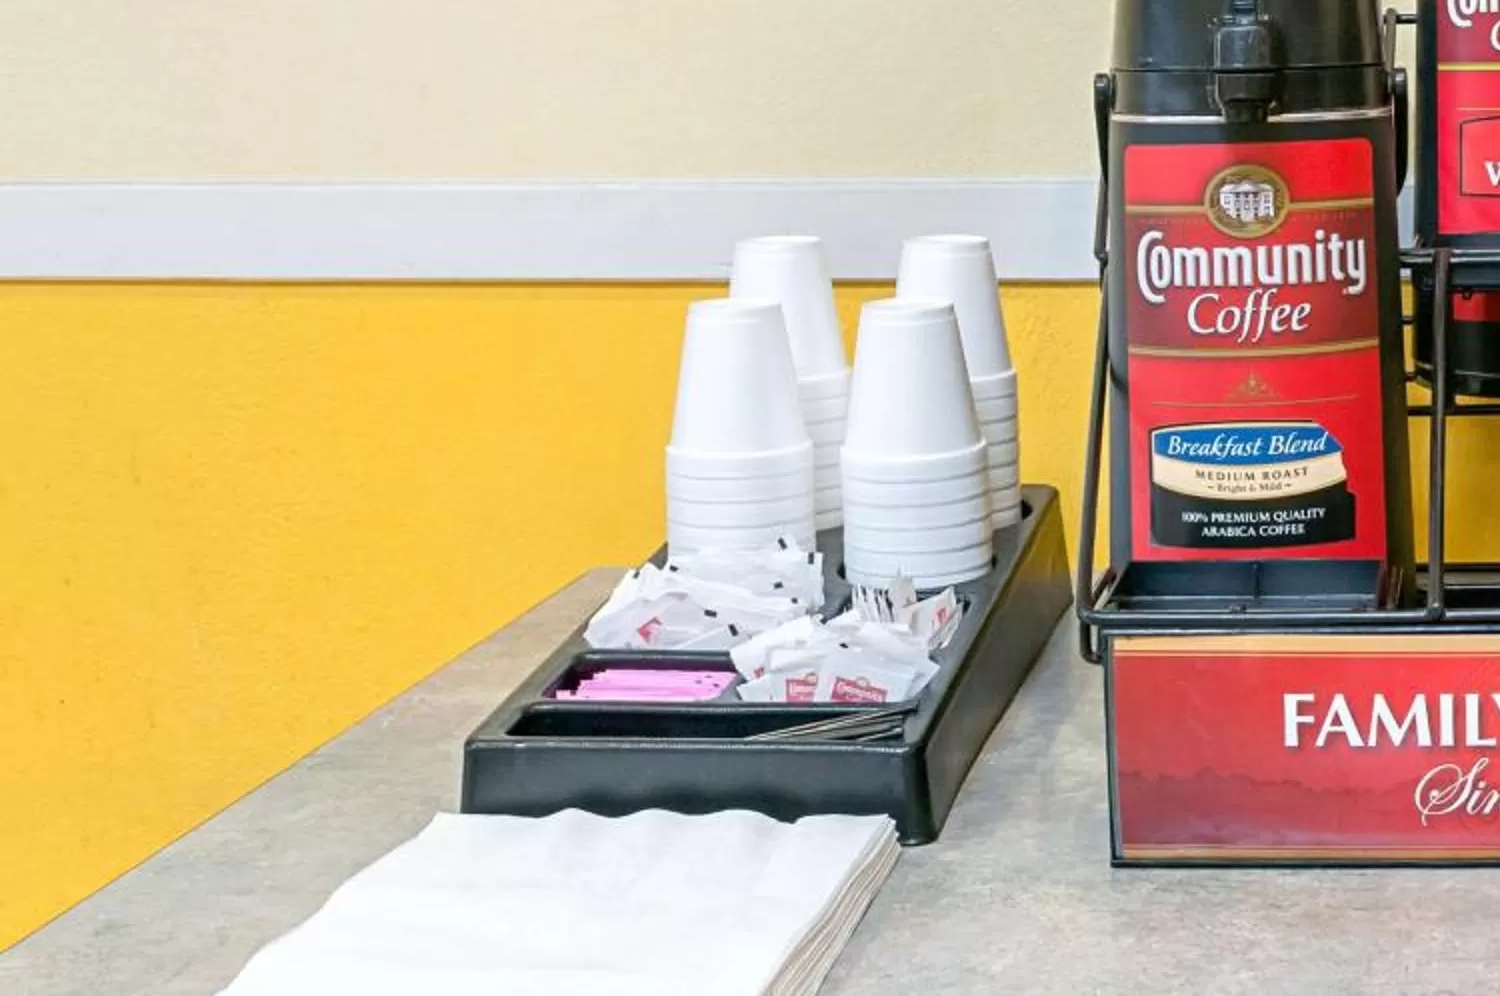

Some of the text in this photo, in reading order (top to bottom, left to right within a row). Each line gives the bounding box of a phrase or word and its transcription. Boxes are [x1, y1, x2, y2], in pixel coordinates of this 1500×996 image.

[1136, 229, 1366, 303] Community
[1186, 287, 1312, 343] Coffee
[1167, 431, 1329, 461] Breakfast Blend
[1194, 467, 1309, 481] MEDIUM ROAST
[1181, 507, 1327, 523] 100% PREMIUM QUALITY
[1201, 523, 1306, 538] ARABICA COFFEE
